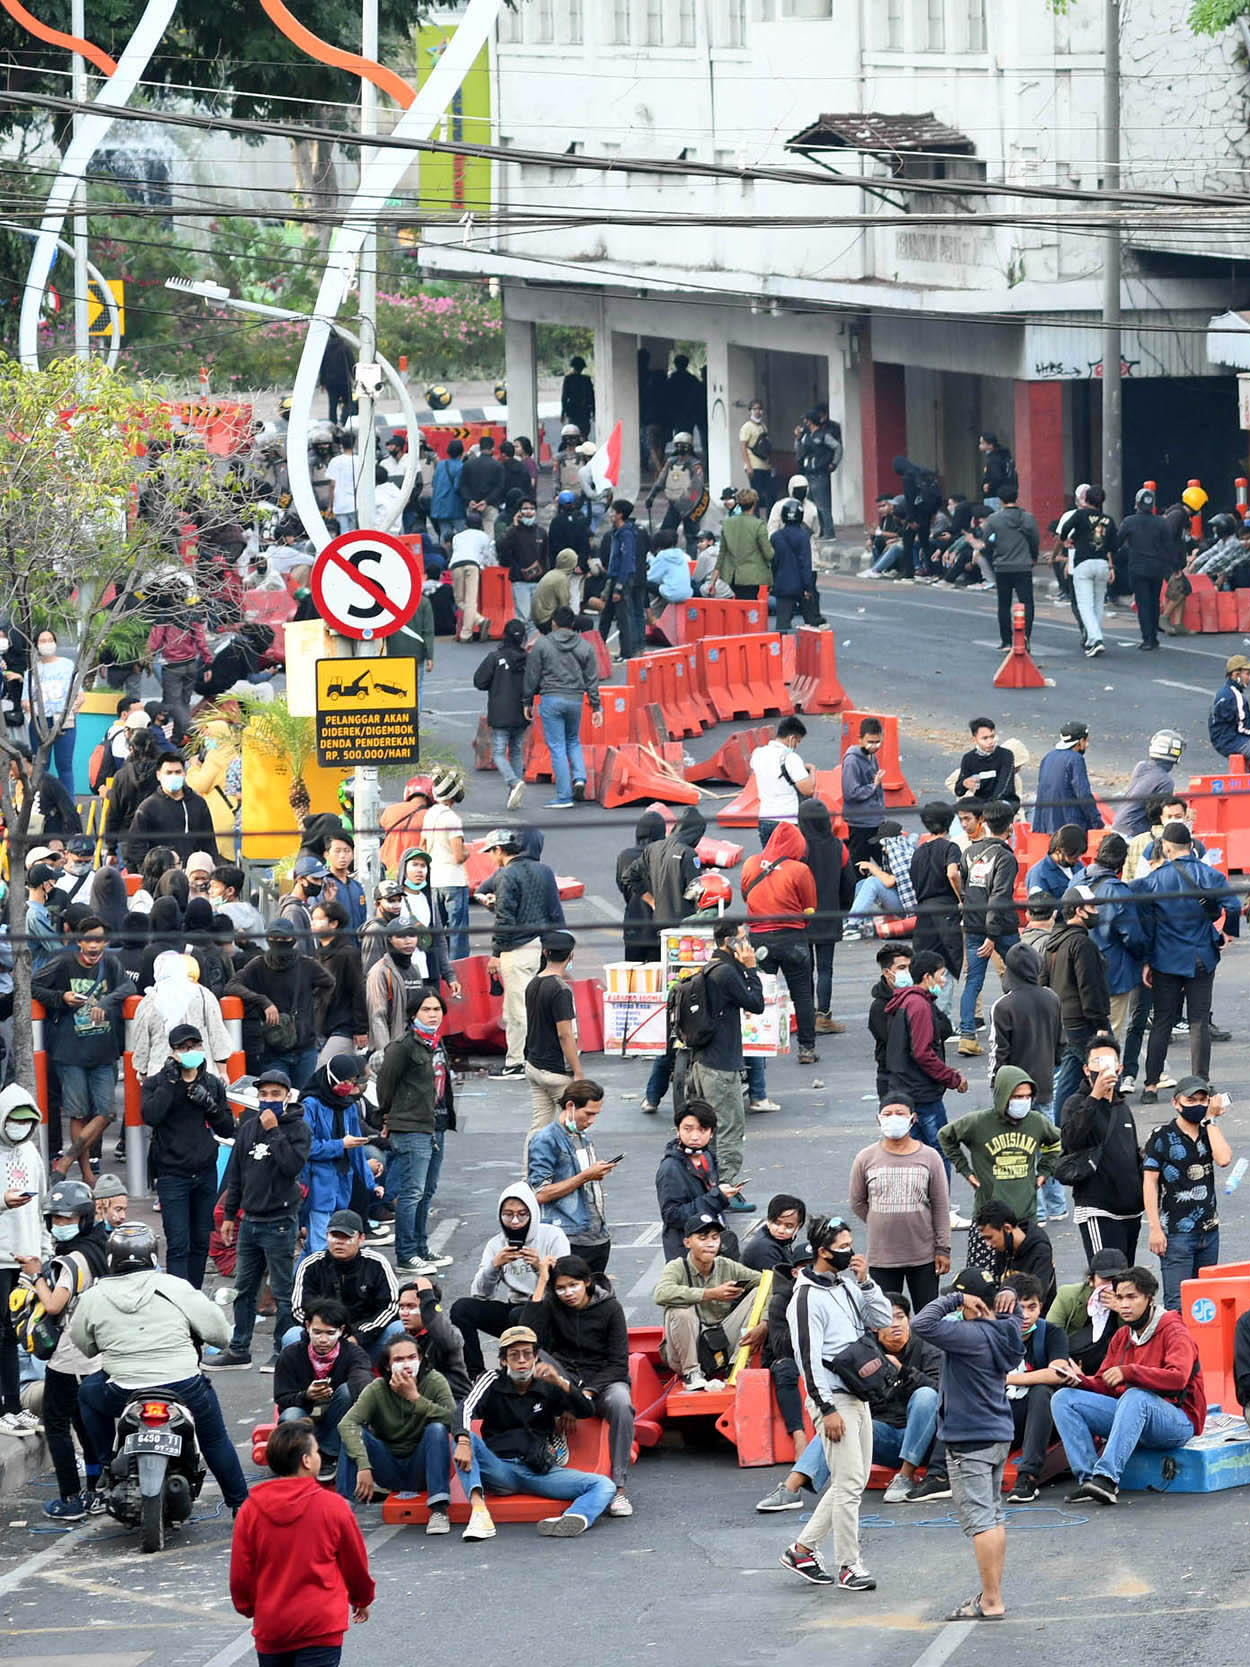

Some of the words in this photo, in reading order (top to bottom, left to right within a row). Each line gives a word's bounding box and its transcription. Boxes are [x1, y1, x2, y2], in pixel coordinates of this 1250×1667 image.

[347, 550, 387, 618] S
[325, 714, 380, 725] PELANGGAR
[383, 713, 409, 723] AKAN
[321, 725, 414, 737] DIDEREK/DIGEMBOK
[320, 739, 352, 749] DENDA
[355, 736, 416, 748] PENDEREKAN
[325, 751, 340, 761] RP.
[343, 748, 411, 760] 500.000/HARI
